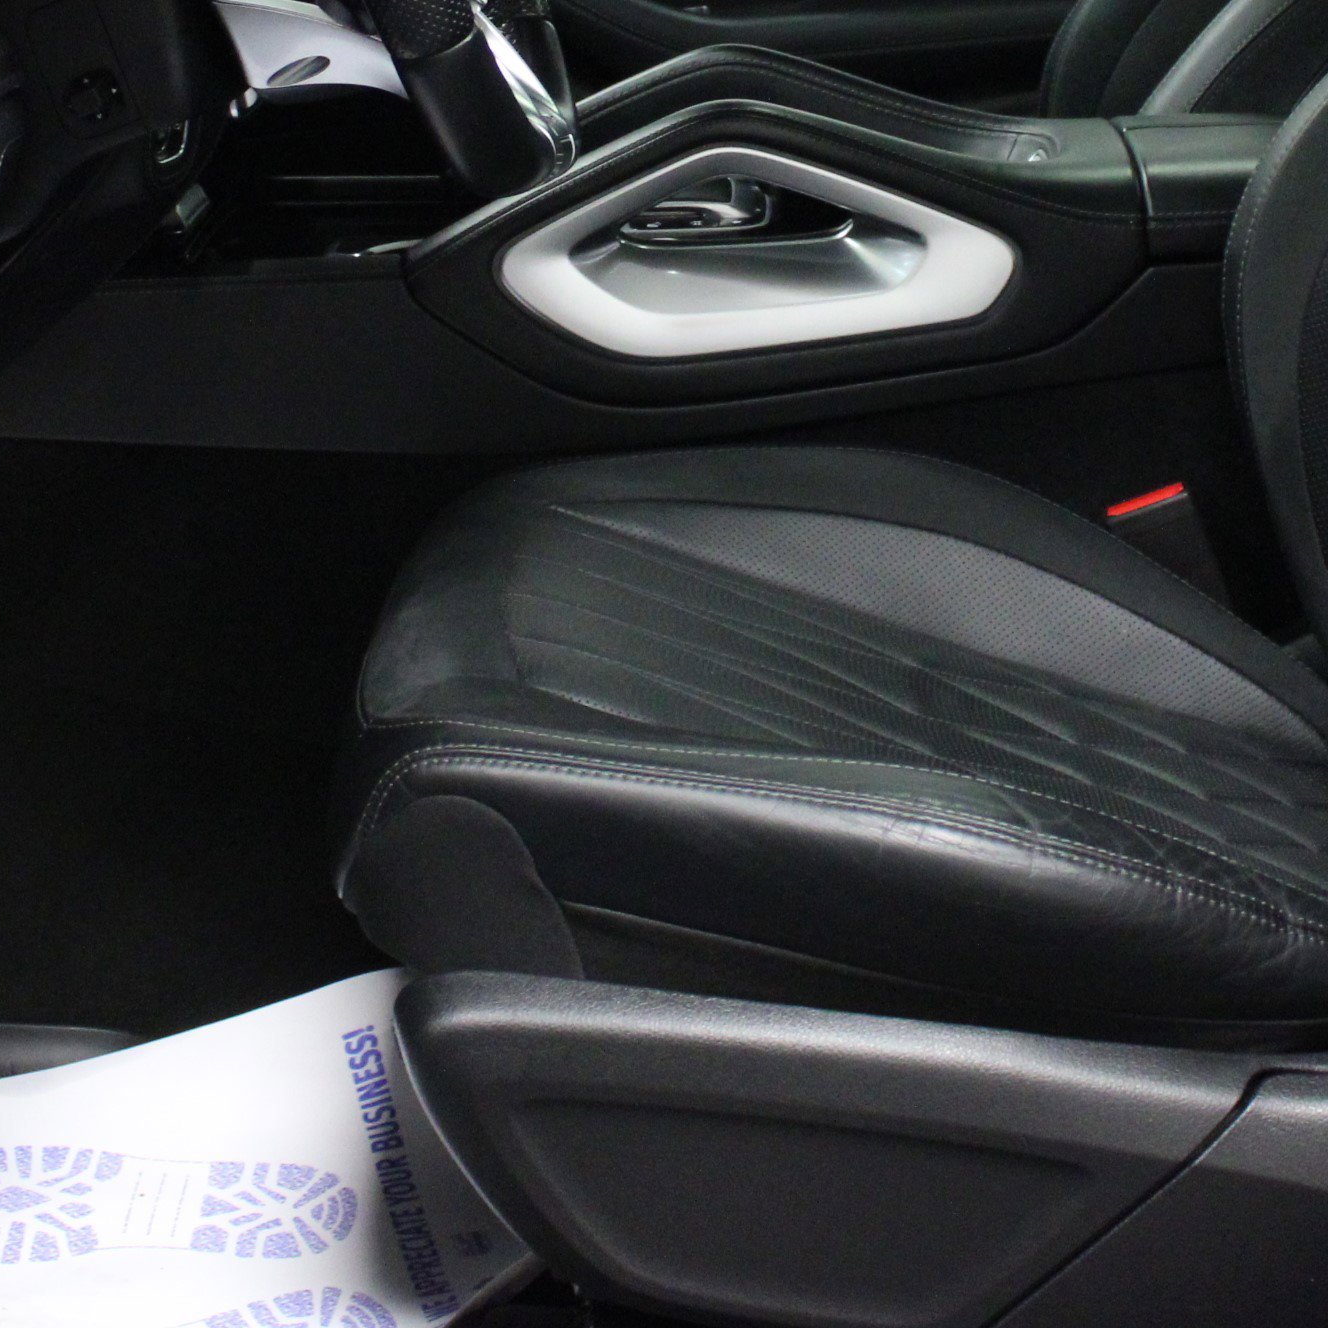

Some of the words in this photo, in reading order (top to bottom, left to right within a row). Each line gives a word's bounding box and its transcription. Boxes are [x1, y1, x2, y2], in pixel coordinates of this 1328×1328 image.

[342, 1024, 404, 1153] BUSINESS!
[375, 1155, 420, 1207] YOUR
[389, 1207, 453, 1297] APPRECIATE
